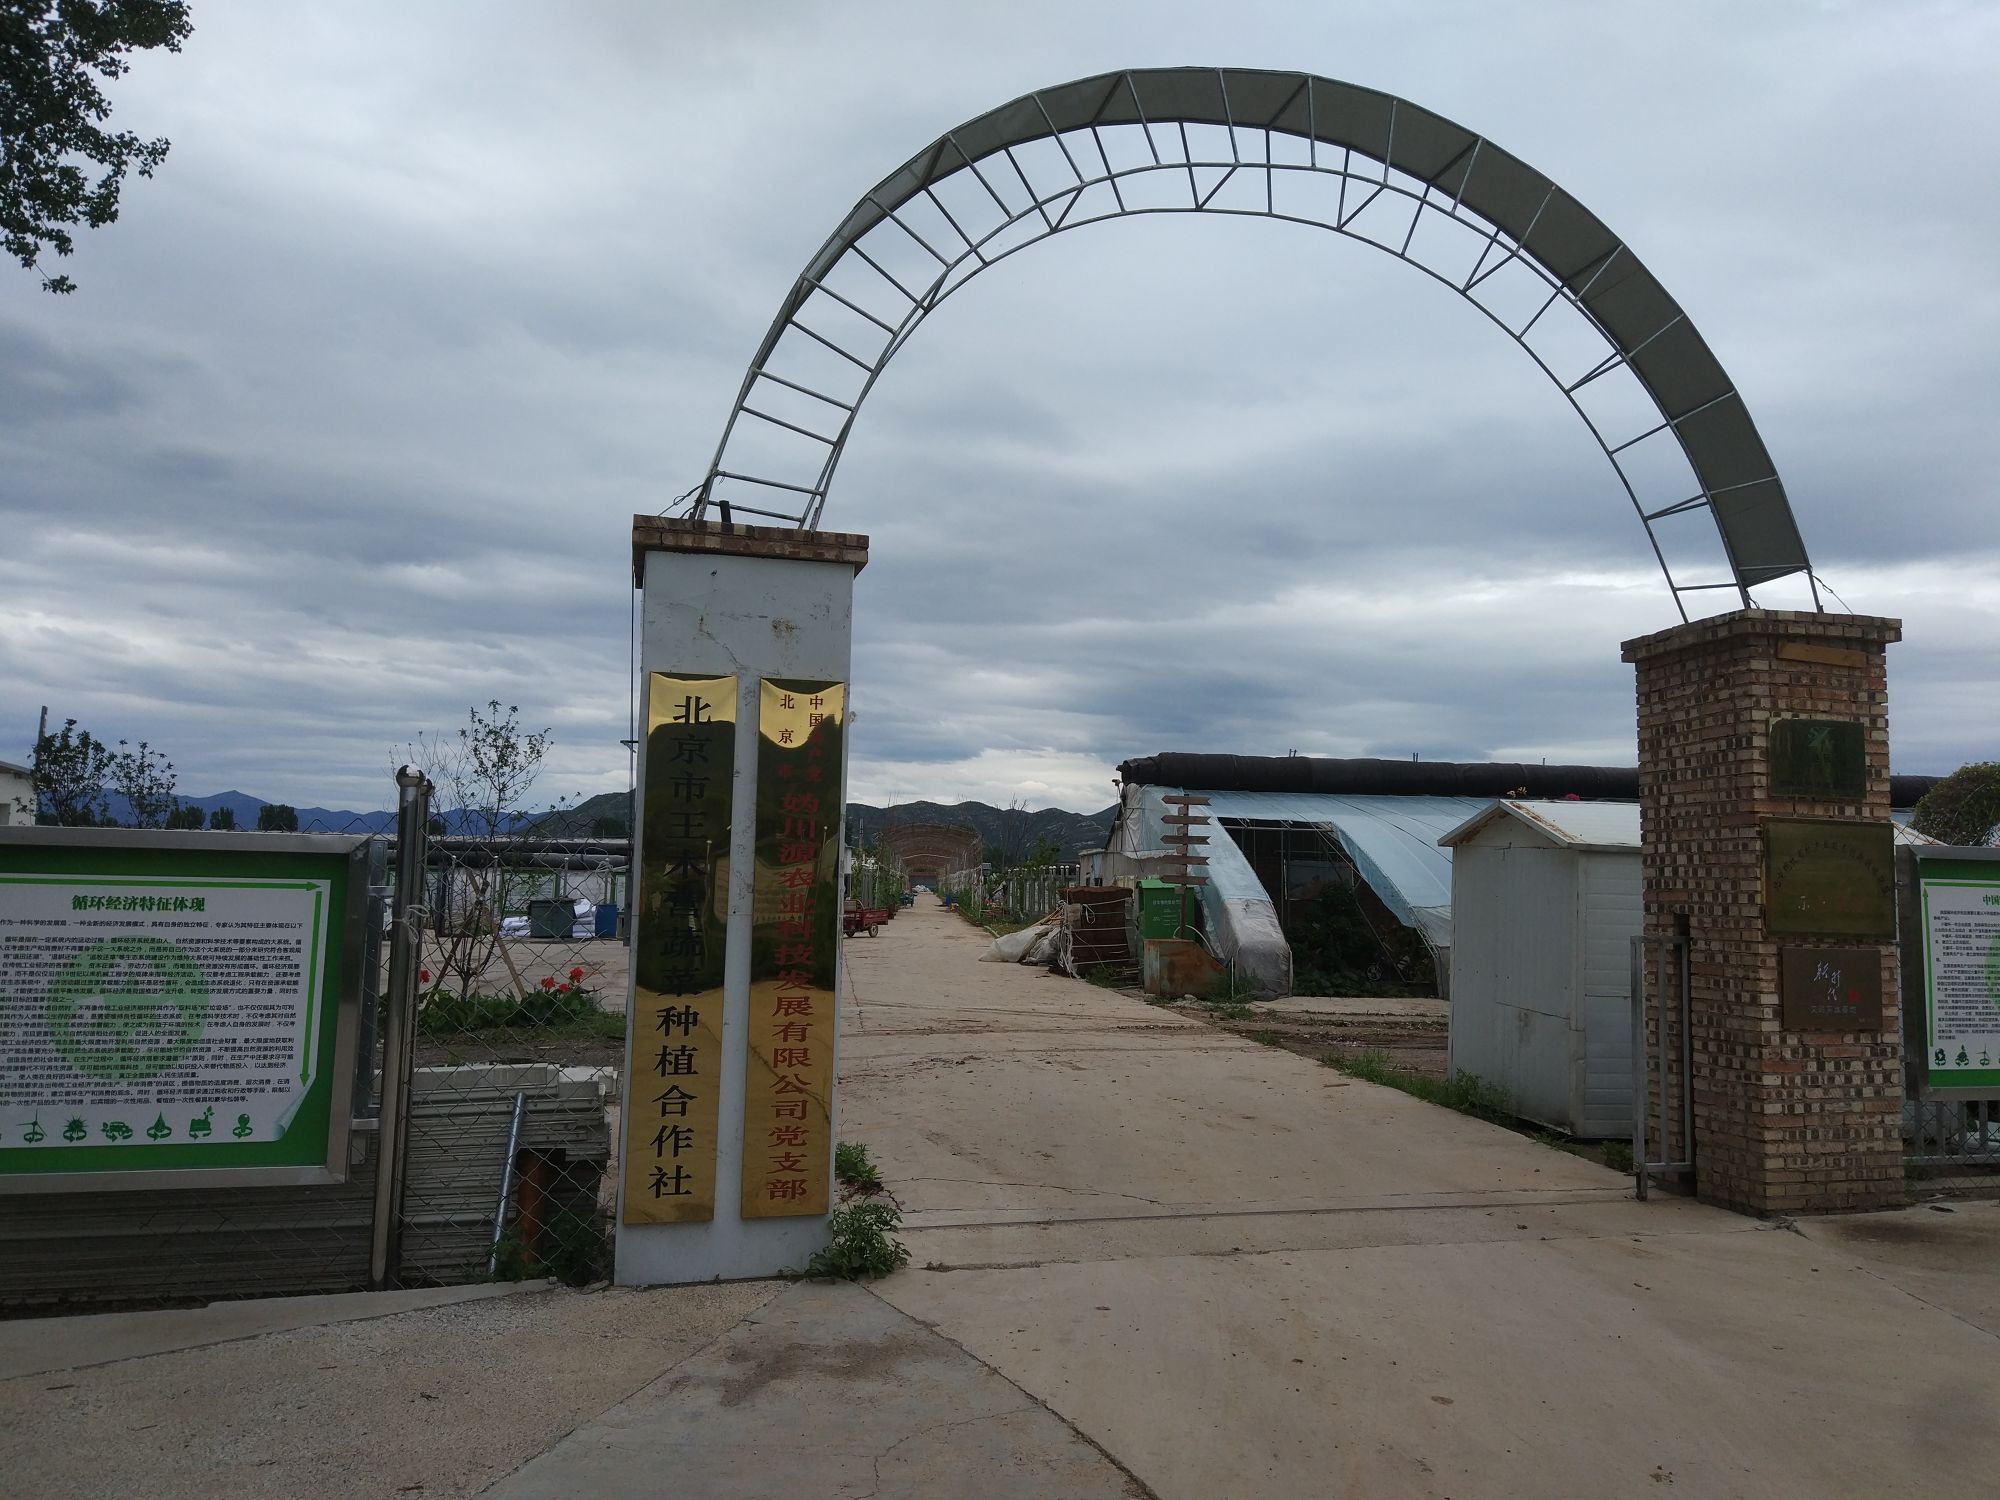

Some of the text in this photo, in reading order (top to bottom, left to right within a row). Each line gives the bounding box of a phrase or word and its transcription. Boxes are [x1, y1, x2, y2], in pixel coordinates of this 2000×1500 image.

[72, 894, 206, 912] 循环经济特征体现
